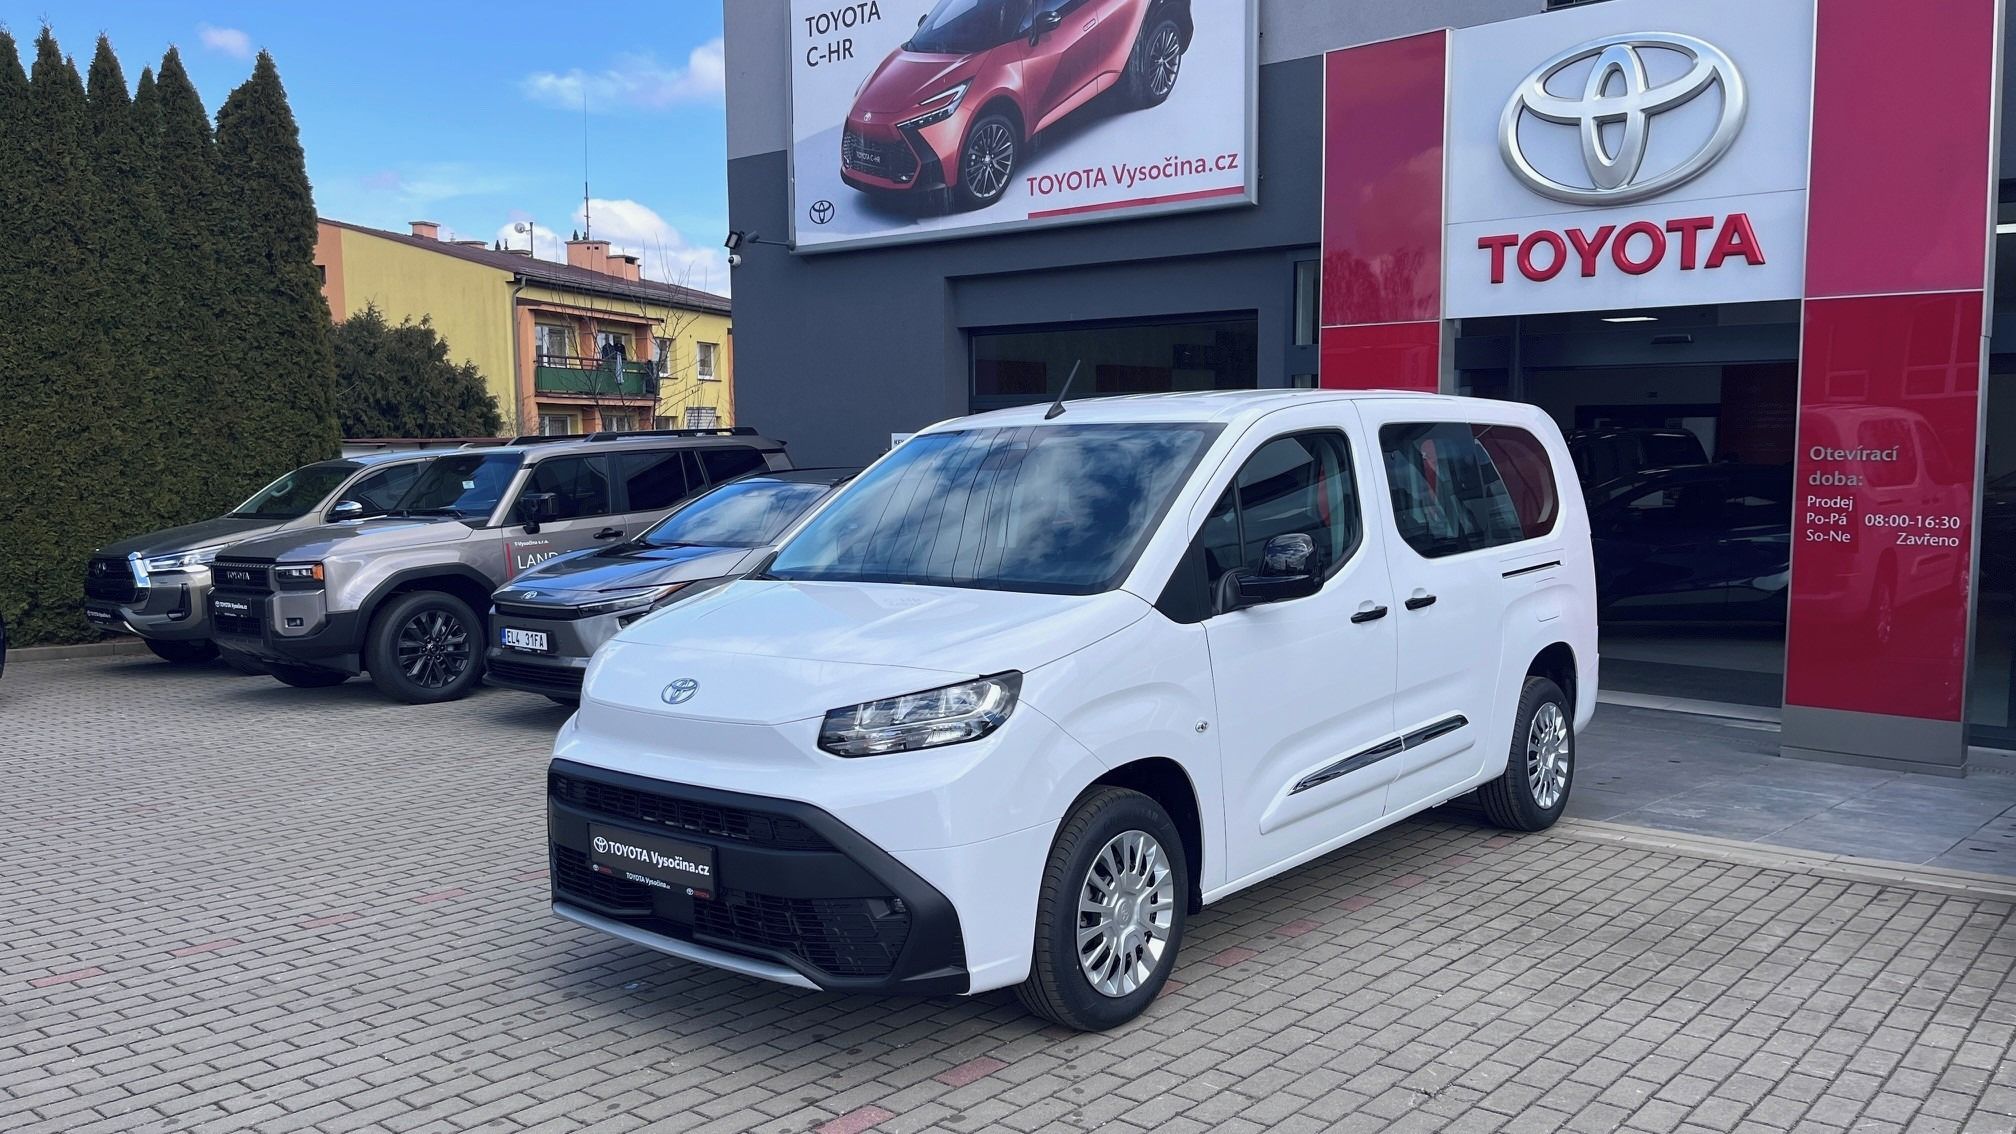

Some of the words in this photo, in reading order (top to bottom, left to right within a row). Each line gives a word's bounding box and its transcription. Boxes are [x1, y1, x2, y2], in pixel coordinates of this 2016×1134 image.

[805, 0, 881, 37] TOYOTA
[806, 38, 854, 67] C-HR
[1027, 167, 1107, 196] TOYOTA
[1112, 153, 1239, 188] Vysočina.cz
[1478, 212, 1766, 284] TOYOTA
[1810, 445, 1899, 461] Otevírací
[1808, 470, 1863, 486] doba:
[1807, 495, 1853, 511] Prodej
[1806, 512, 1847, 525] Po-Pá
[1864, 514, 1960, 529] 08:00-16:30
[1806, 529, 1851, 543] So-Ne
[1896, 532, 1959, 547] Zavřeno
[227, 571, 250, 580] TOYOTA
[507, 630, 520, 645] EL4
[525, 633, 544, 648] 31FA
[609, 841, 650, 863] TOYOTA
[650, 851, 710, 876] Vysočina.cz
[626, 872, 645, 883] TOYOTA
